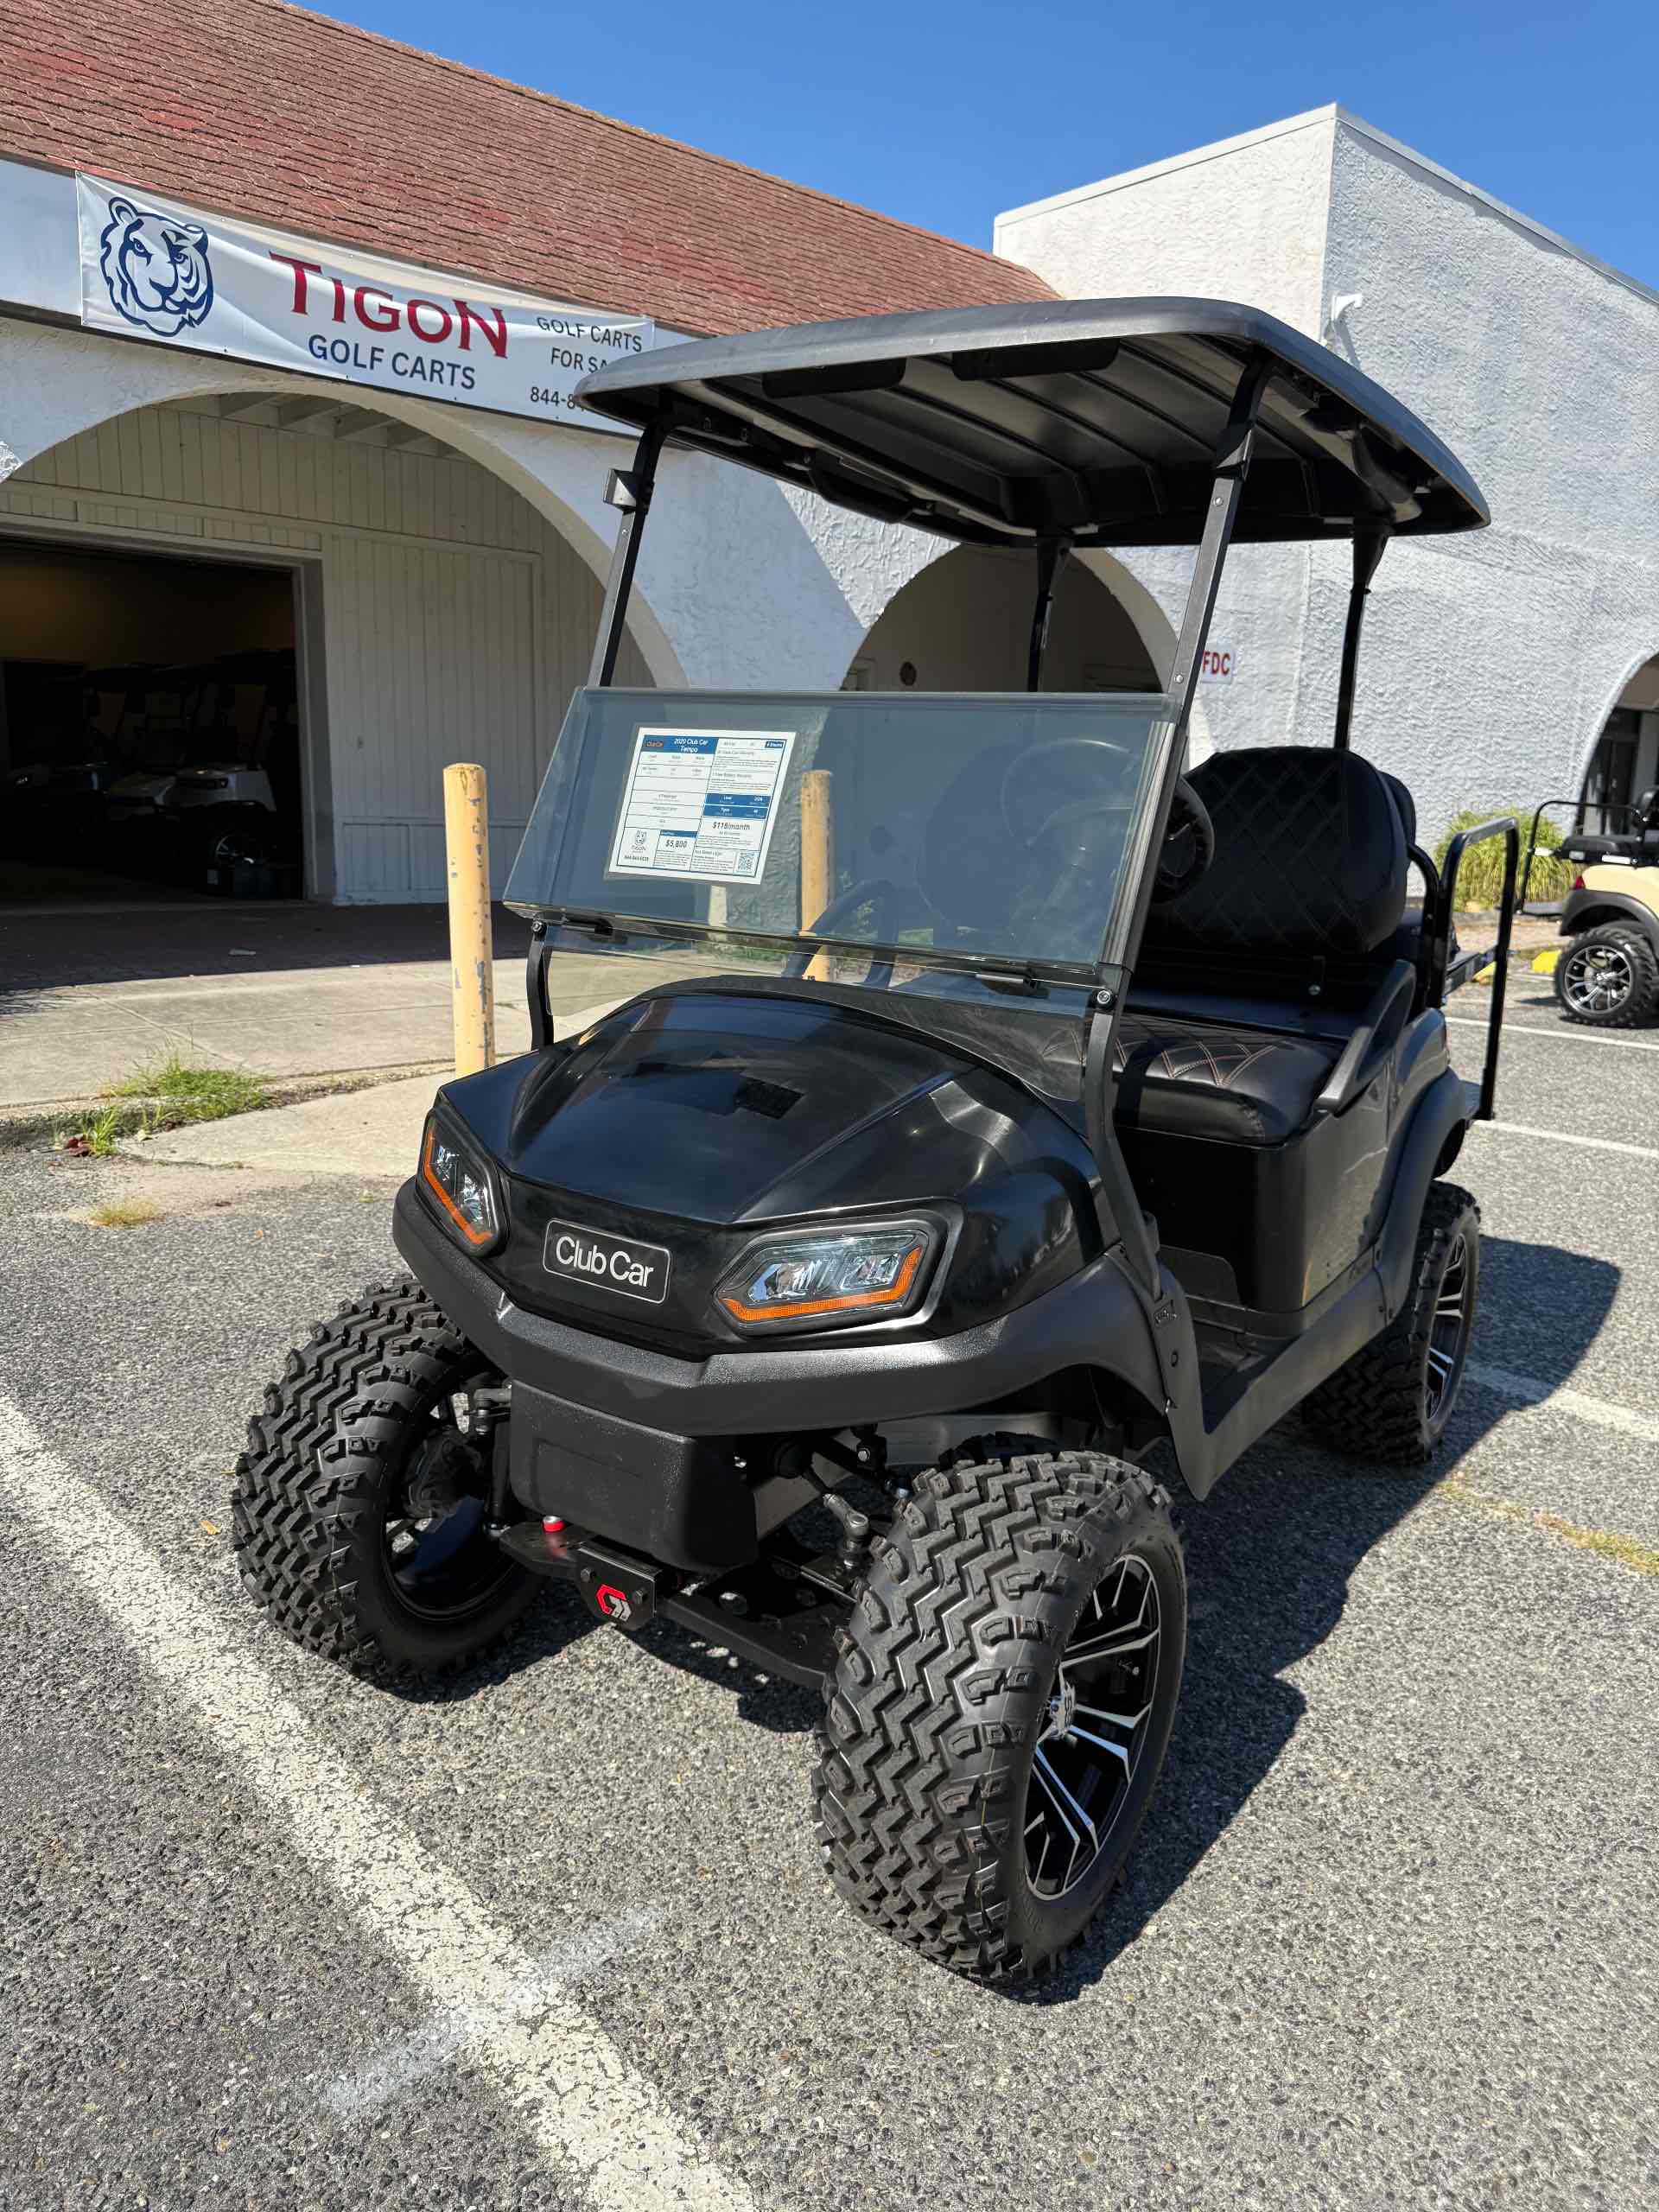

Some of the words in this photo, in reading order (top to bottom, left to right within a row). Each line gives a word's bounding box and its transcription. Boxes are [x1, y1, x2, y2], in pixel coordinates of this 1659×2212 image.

[269, 251, 508, 359] TIGON
[537, 316, 585, 338] GOLF
[590, 325, 642, 353] CARTS
[308, 334, 385, 370] GOLF
[391, 352, 475, 390] CARTS
[550, 347, 585, 372] FOR
[530, 386, 587, 413] 844-8
[1202, 649, 1231, 677] FDC
